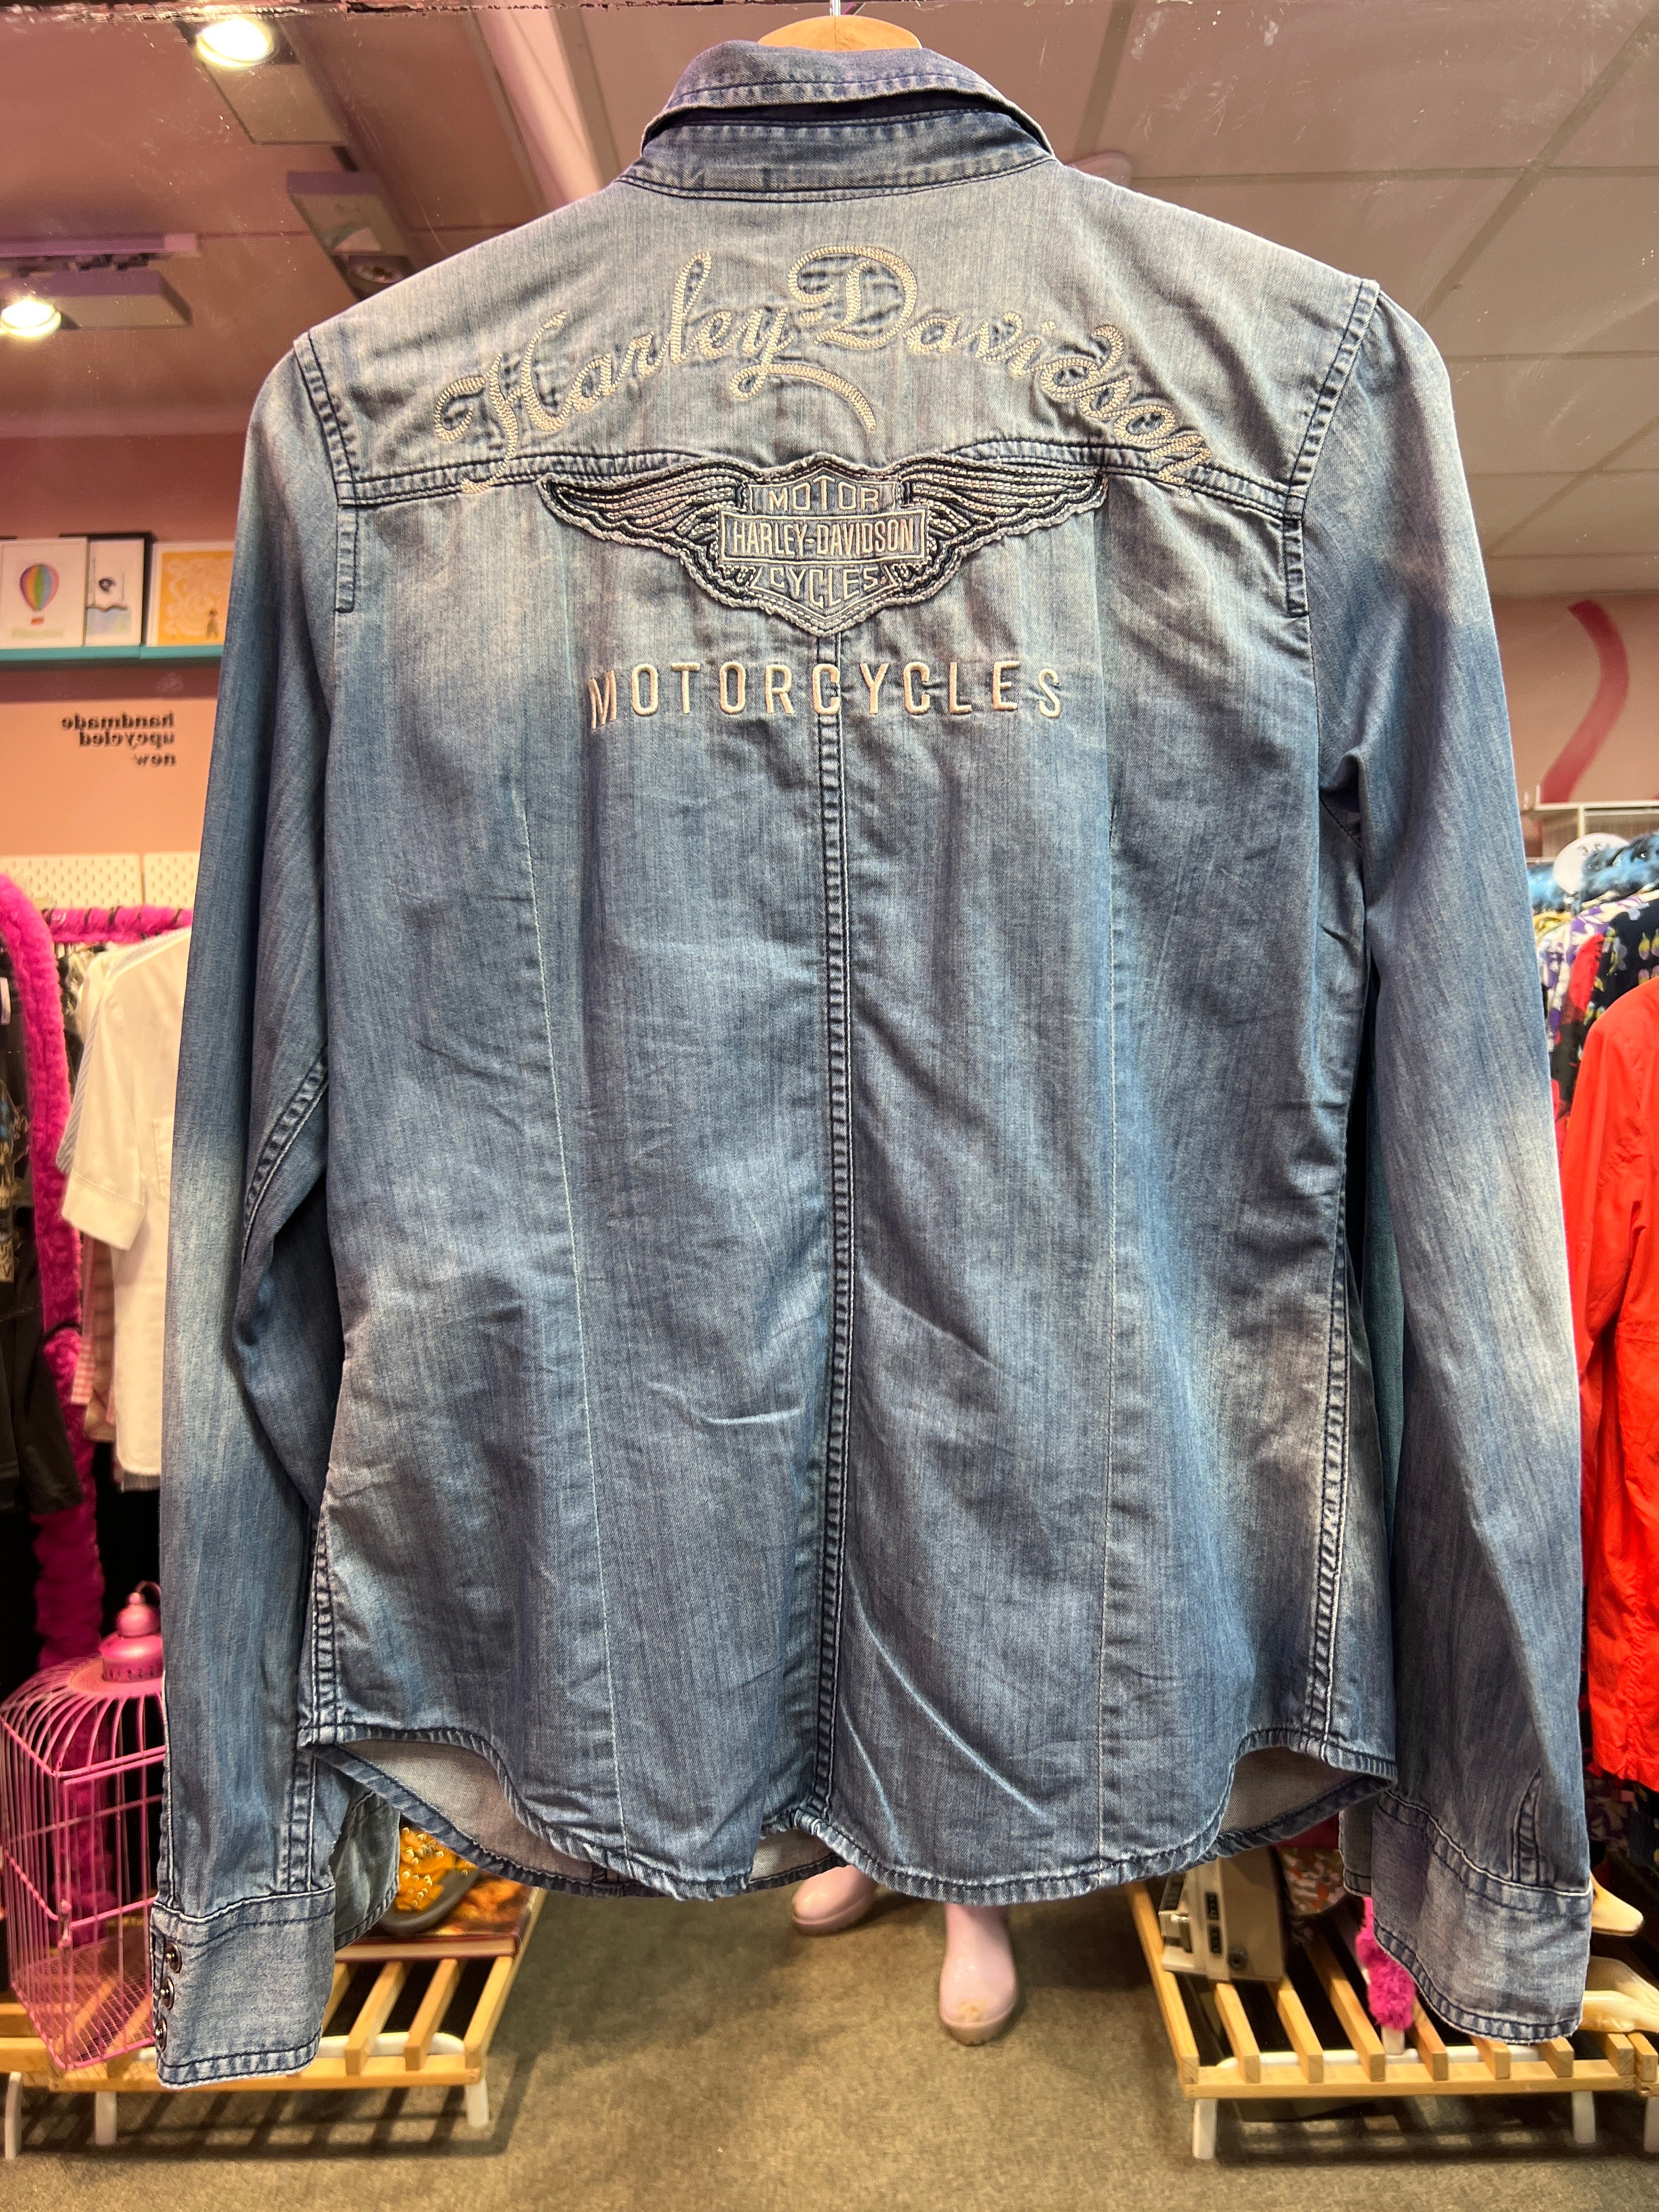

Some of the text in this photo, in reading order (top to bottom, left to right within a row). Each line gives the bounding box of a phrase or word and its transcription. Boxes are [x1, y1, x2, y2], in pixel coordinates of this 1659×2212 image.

[769, 475, 879, 511] MOTOR
[732, 518, 915, 558] HARLEY-DAVIDSON
[769, 566, 878, 609] CYCLES
[588, 661, 1062, 730] MOTORCYCLES
